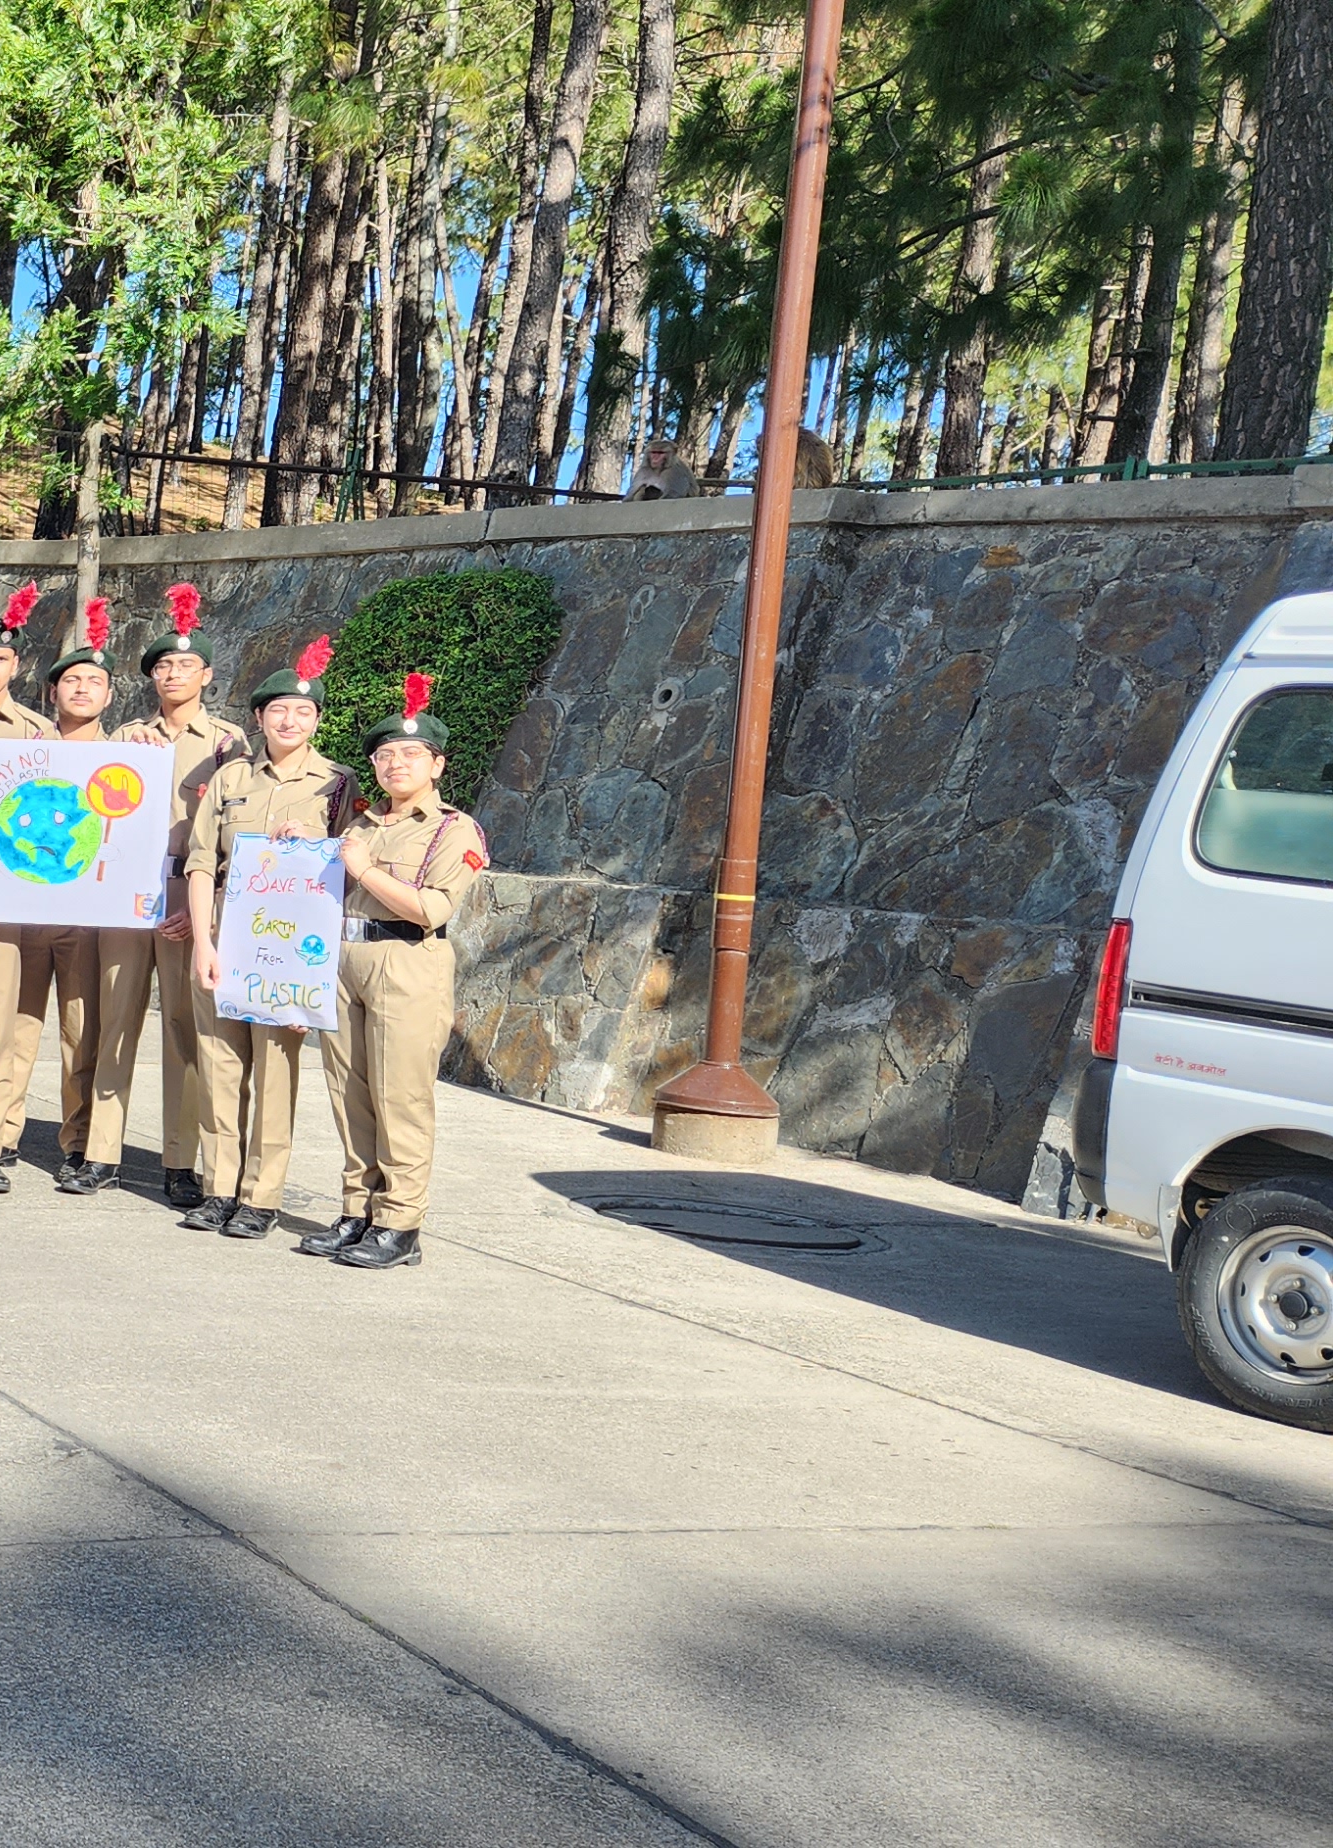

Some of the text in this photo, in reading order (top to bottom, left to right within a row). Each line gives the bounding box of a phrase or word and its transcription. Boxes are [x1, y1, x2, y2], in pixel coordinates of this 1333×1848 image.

[4, 768, 50, 790] PLASTIC
[304, 878, 326, 894] THE
[251, 907, 296, 939] EARTH
